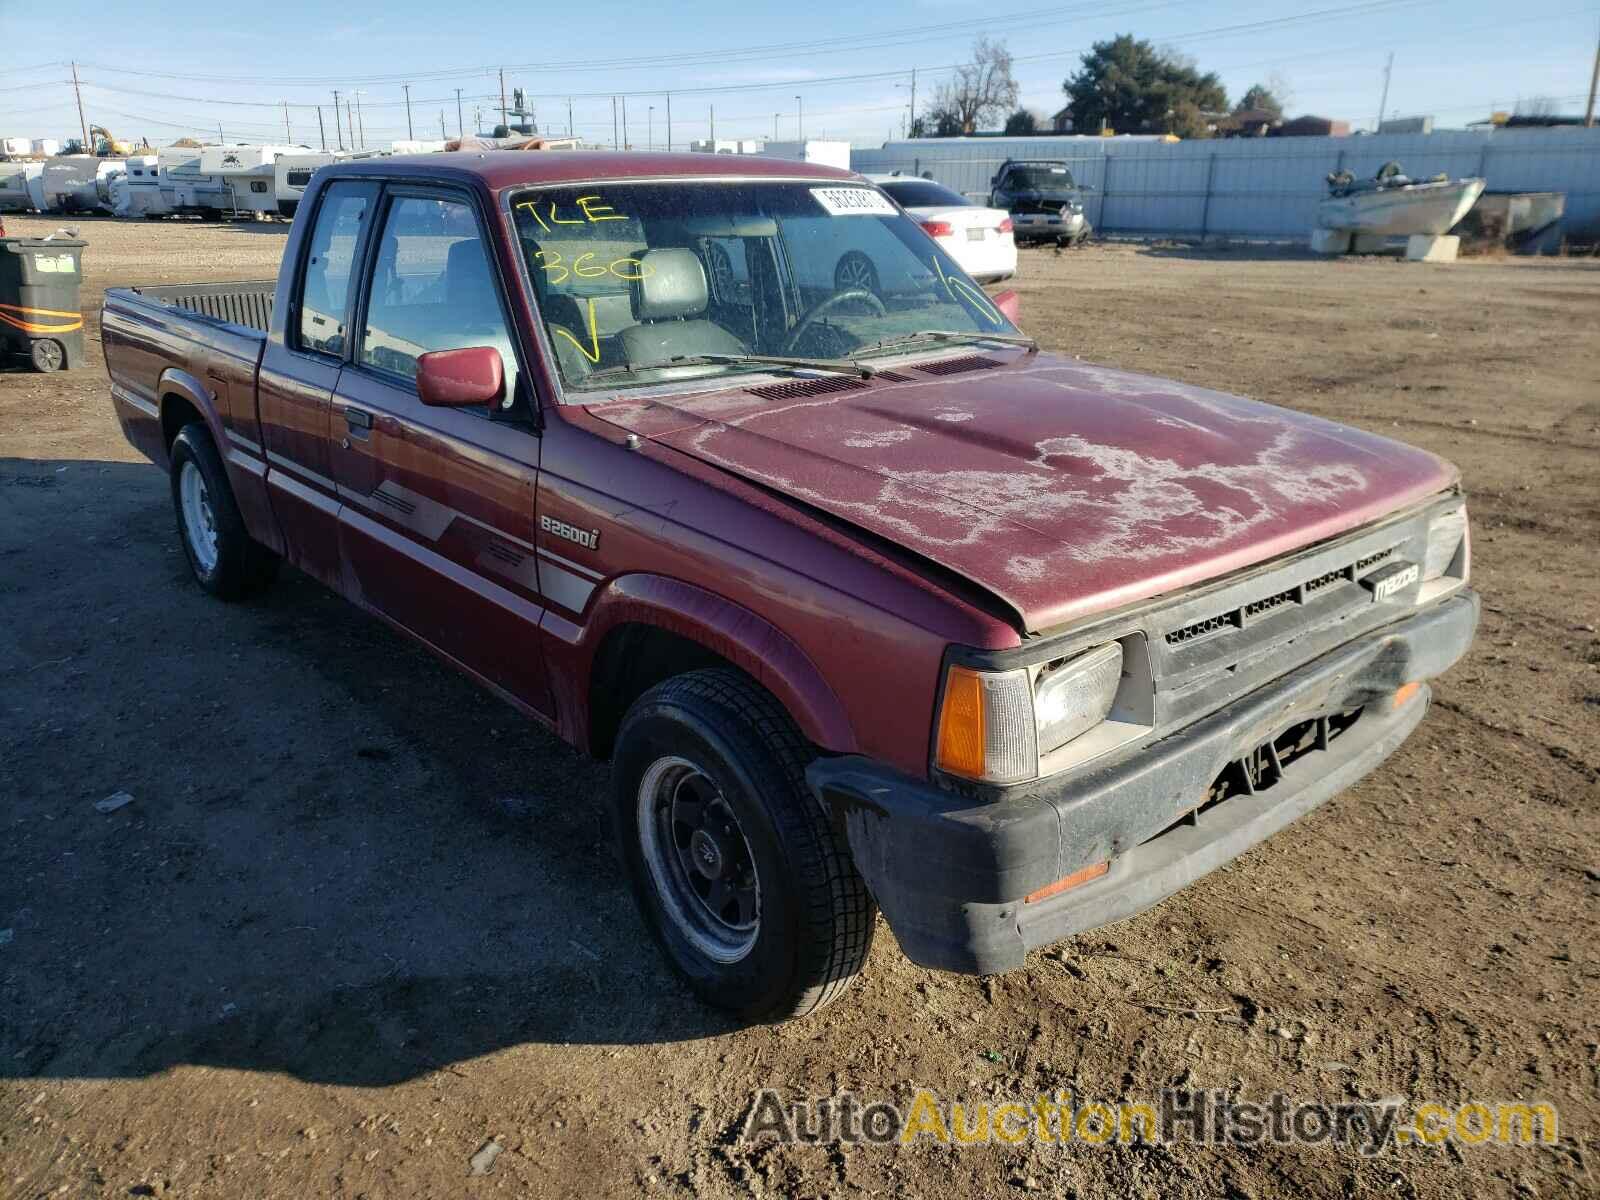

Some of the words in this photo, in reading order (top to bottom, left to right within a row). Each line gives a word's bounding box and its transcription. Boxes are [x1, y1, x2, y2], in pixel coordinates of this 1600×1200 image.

[516, 196, 630, 232] TLE
[535, 251, 657, 284] 360
[541, 515, 600, 549] B2600i
